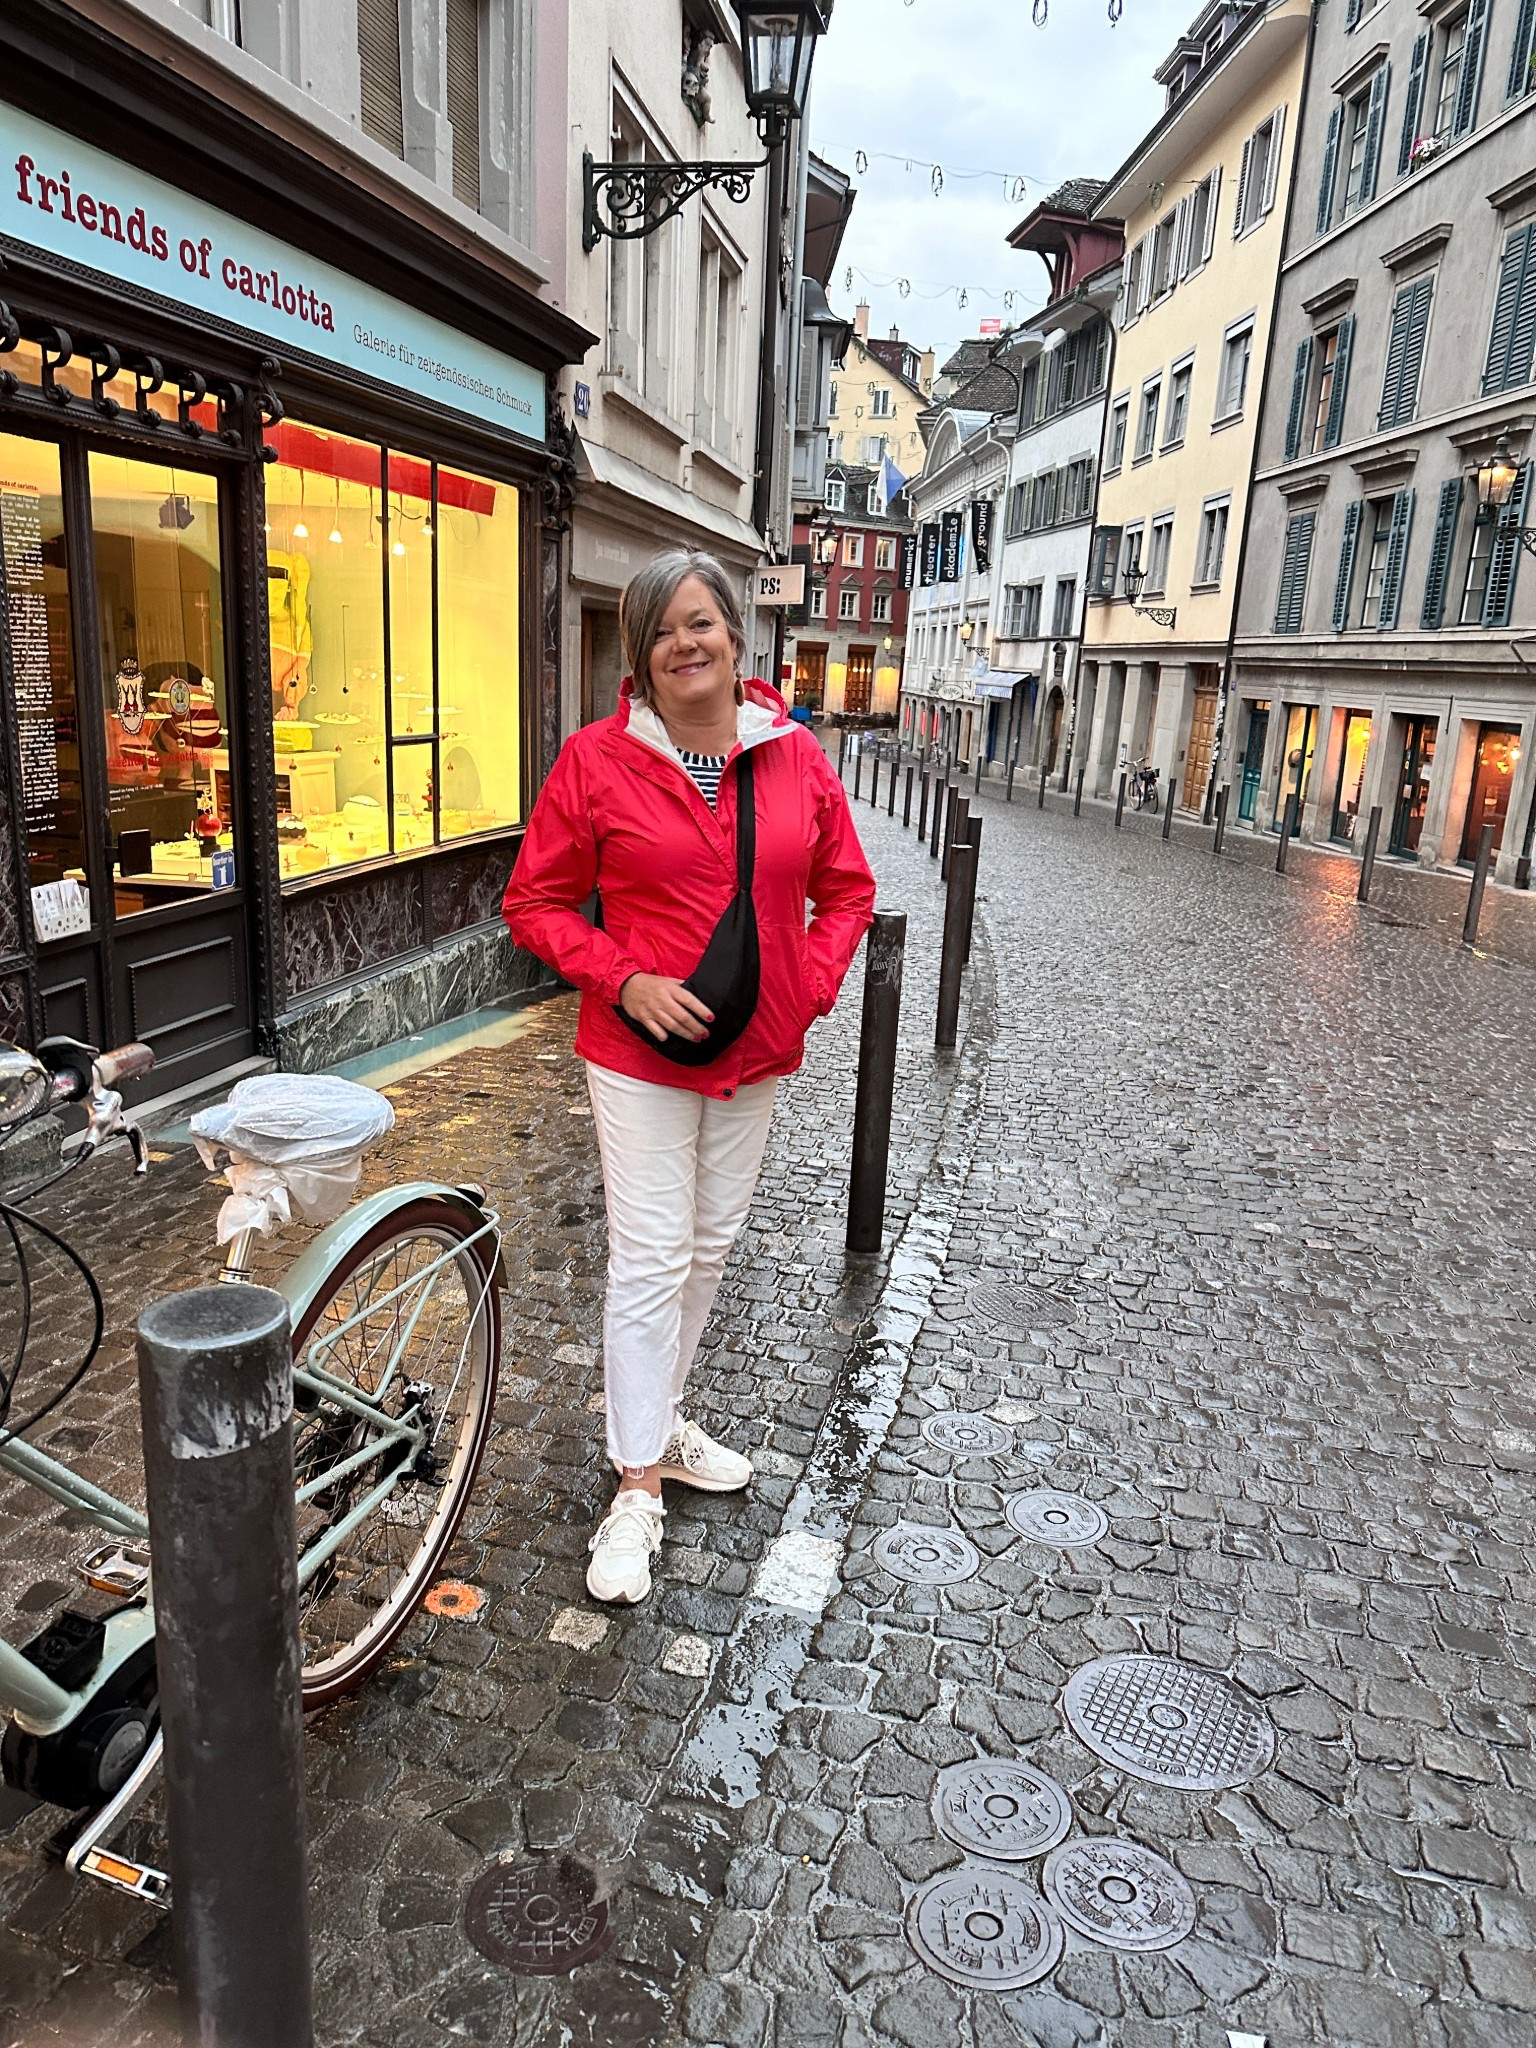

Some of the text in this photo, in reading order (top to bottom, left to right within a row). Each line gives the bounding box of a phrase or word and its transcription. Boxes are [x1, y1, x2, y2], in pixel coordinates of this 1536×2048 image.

[14, 153, 335, 333] friends of carlotta
[353, 324, 533, 416] Galerie für zeitgenössischen Schmuck
[578, 388, 588, 413] 20
[904, 537, 915, 588] neumarkt
[923, 534, 936, 584] theater
[943, 518, 958, 578] akademie
[218, 865, 227, 885] 1
